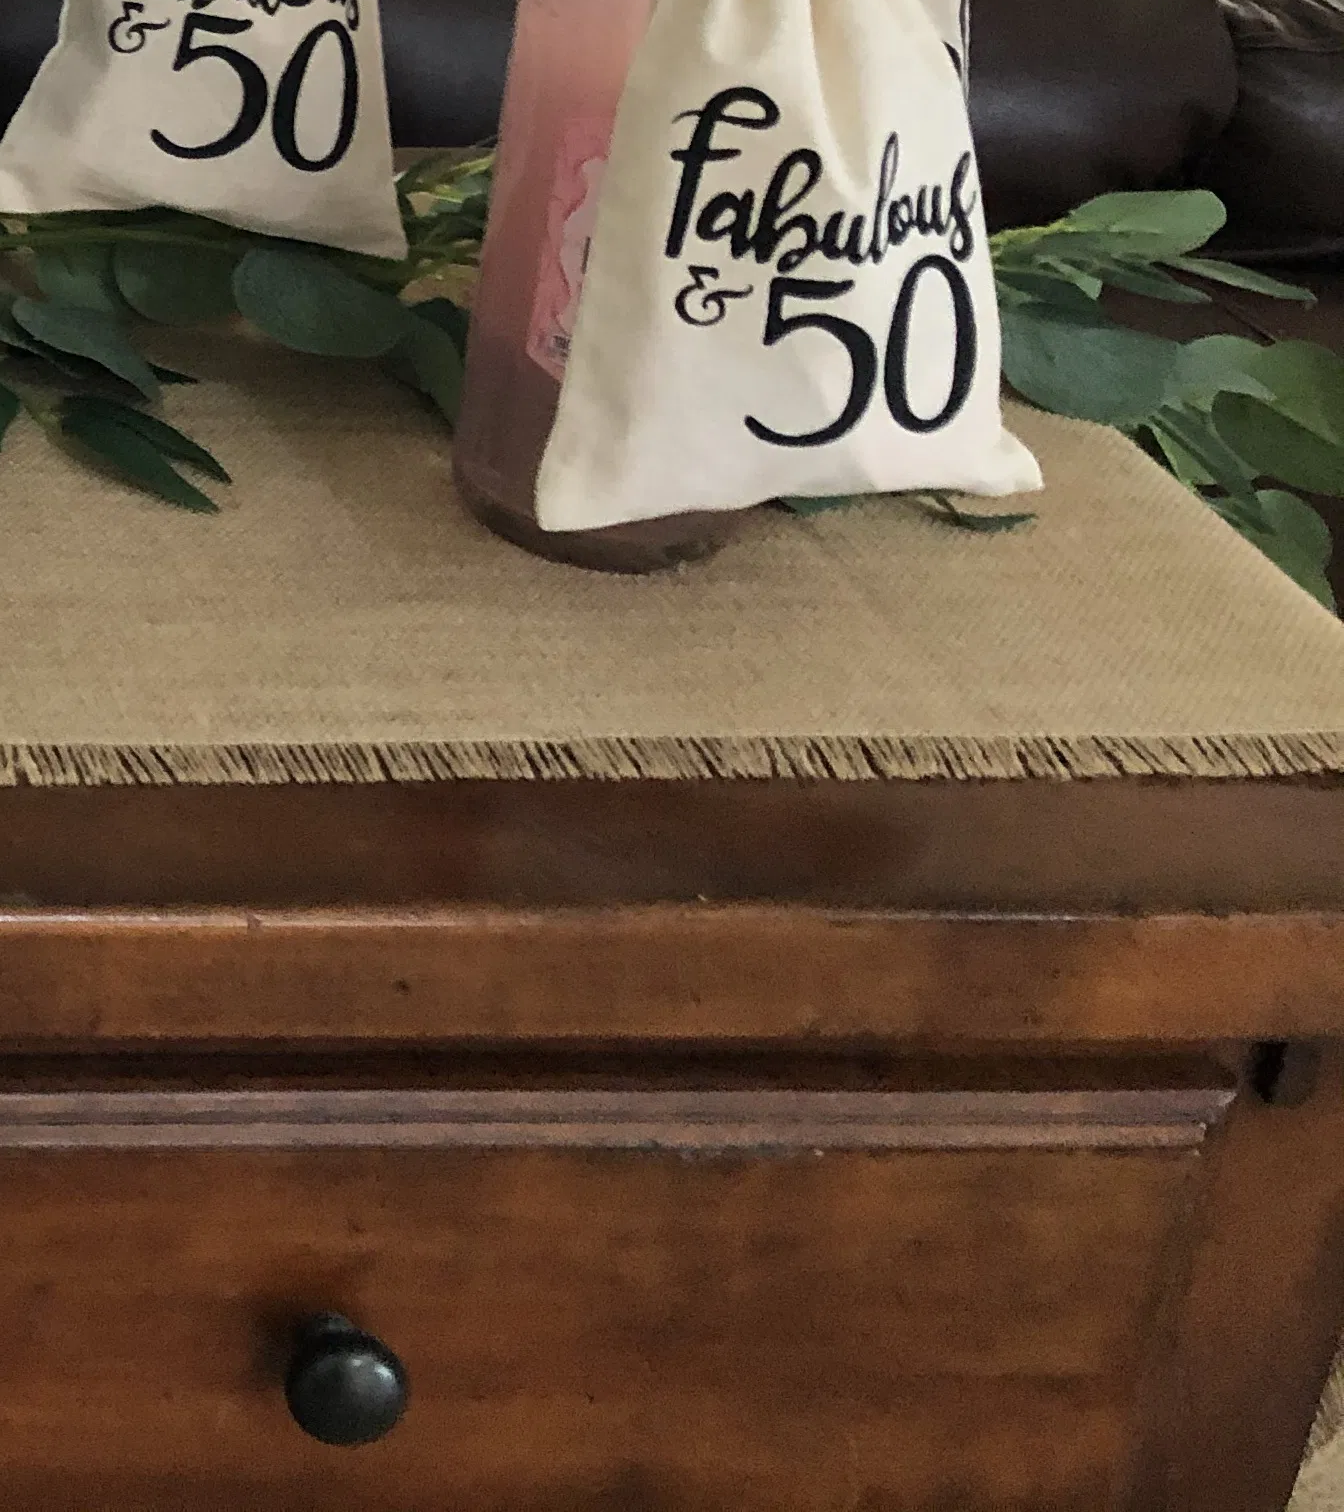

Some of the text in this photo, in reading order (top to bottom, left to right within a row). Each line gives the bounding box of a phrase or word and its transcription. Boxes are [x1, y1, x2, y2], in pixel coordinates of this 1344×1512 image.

[107, 1, 359, 173] & 50
[673, 253, 979, 449] & 50
